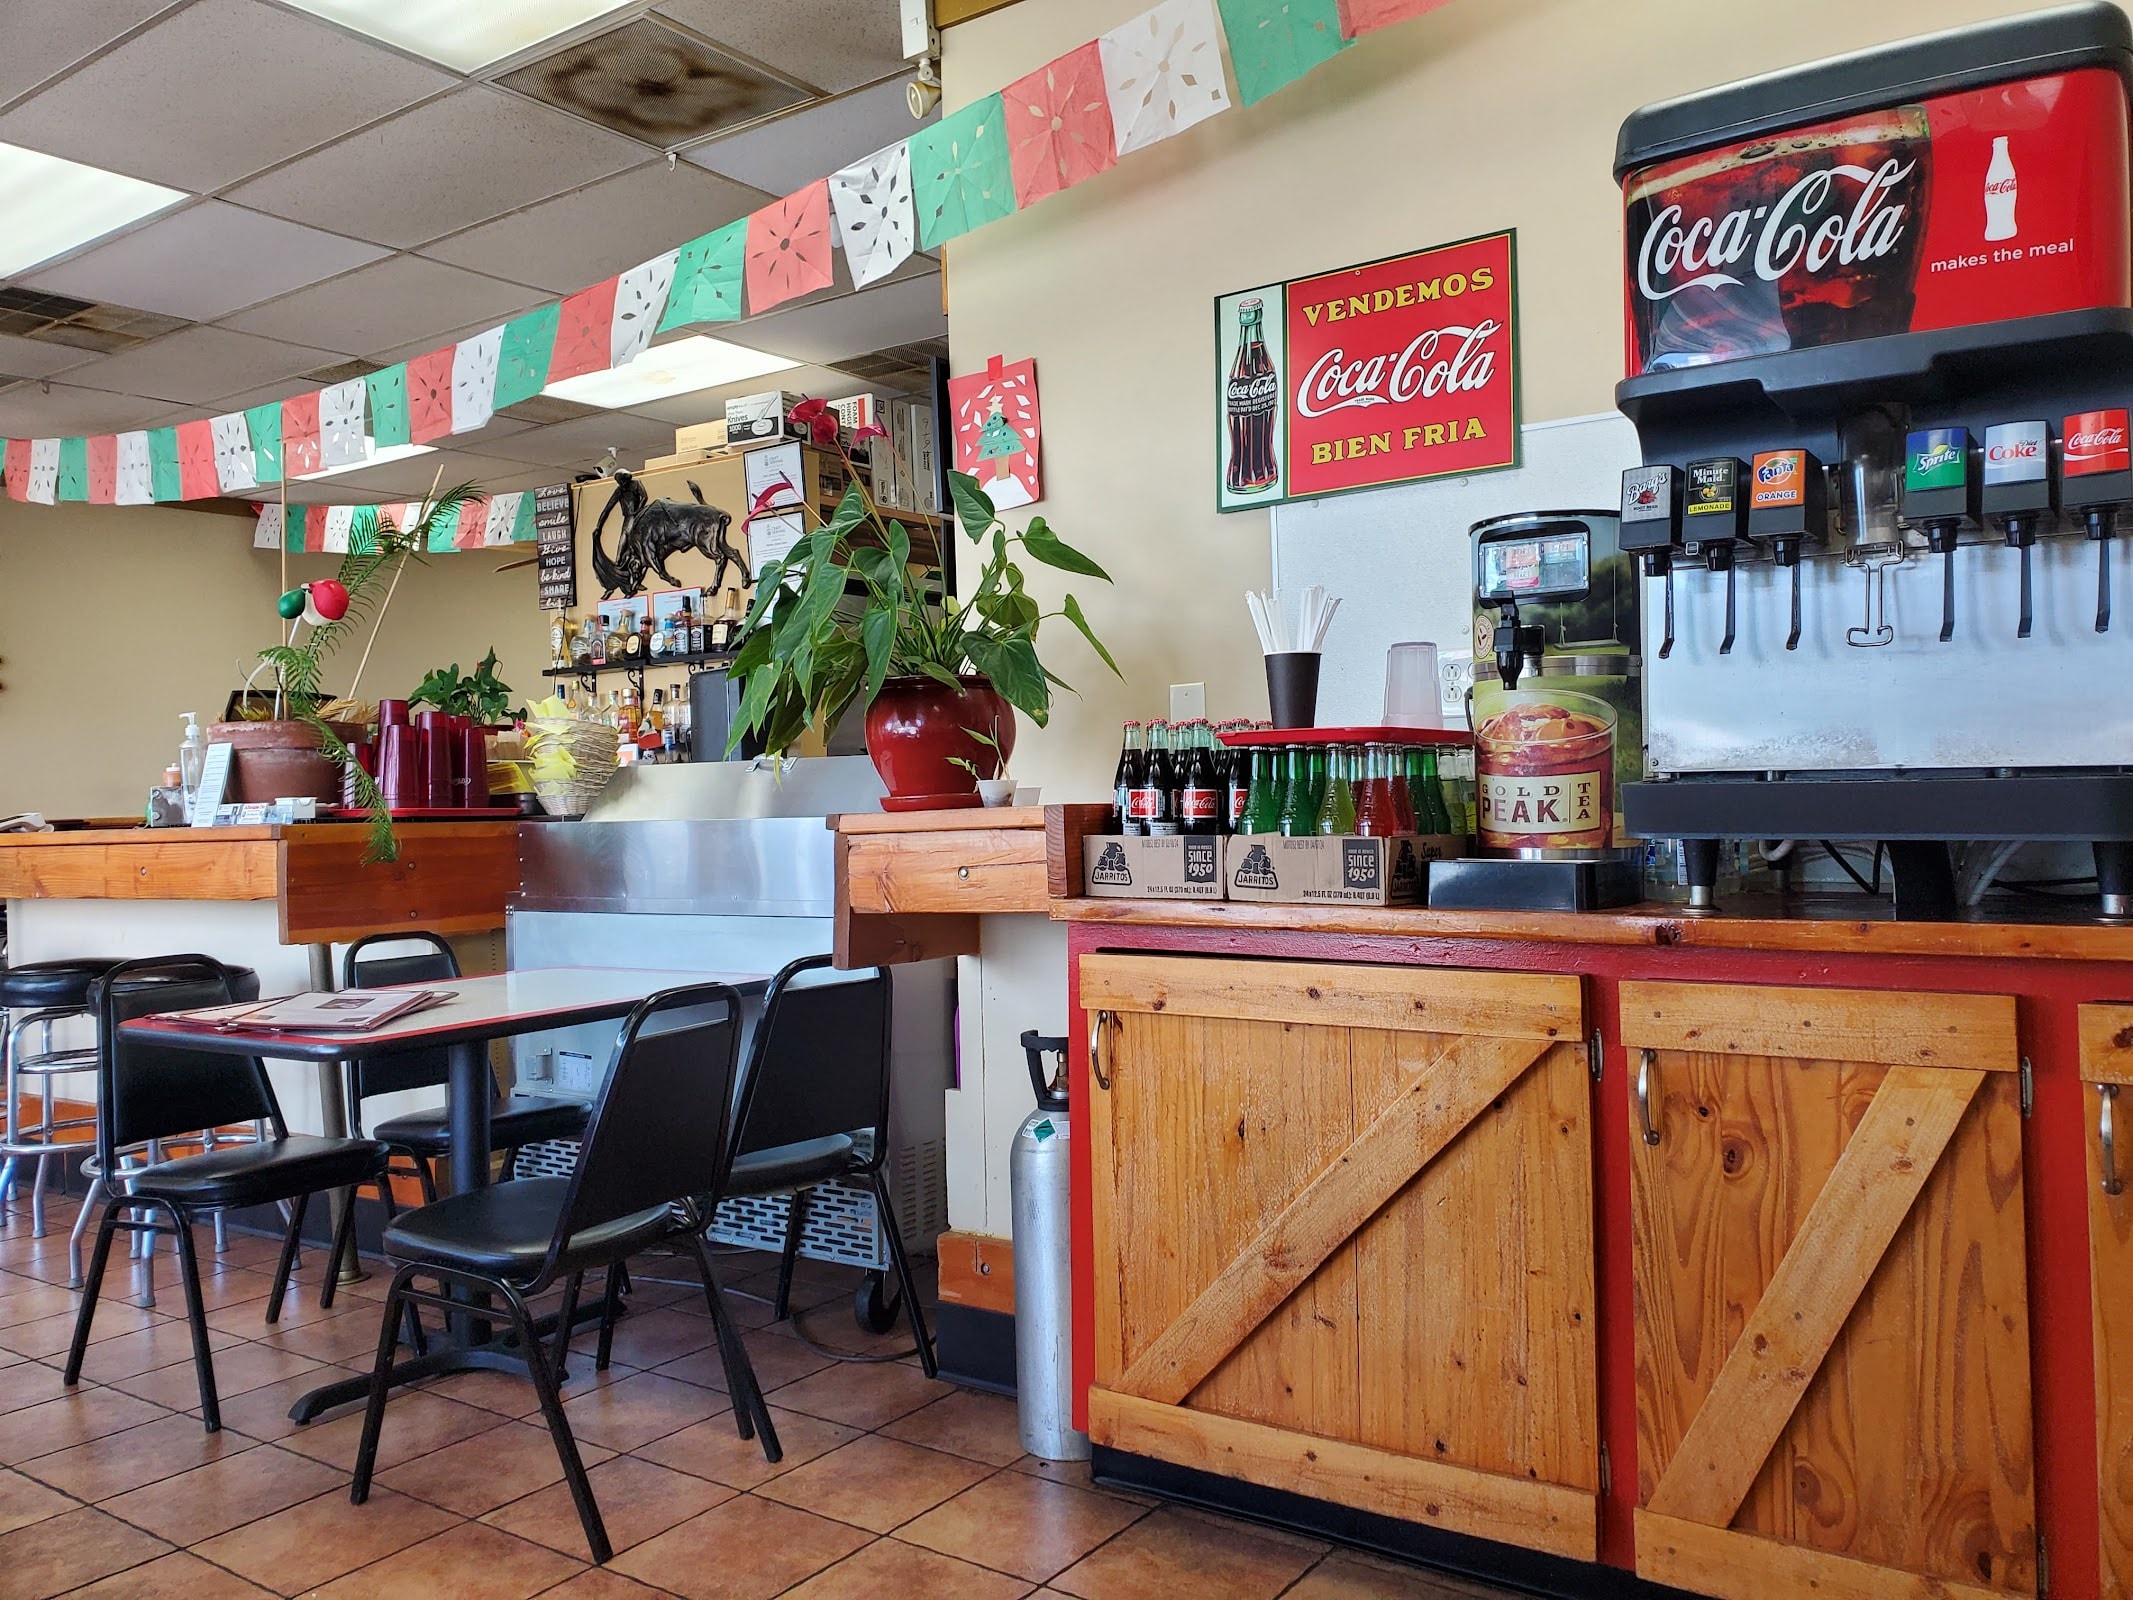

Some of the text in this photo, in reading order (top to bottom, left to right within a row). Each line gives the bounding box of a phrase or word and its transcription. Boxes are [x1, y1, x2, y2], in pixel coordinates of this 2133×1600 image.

[1637, 157, 1917, 300] Coca-Cola
[1930, 238, 2074, 273] makes the meal
[1302, 267, 1495, 327] VENDEMOS
[1297, 319, 1503, 419] Coca-Cola
[1228, 373, 1276, 399] Coca-Cola
[728, 415, 749, 424] Knives
[1311, 417, 1488, 466] BIEN FRIA
[2067, 427, 2125, 450] Coca-Cola
[1918, 449, 1957, 472] Sprite
[1989, 444, 2038, 462] Coke
[1693, 467, 1729, 478] Minute
[1696, 474, 1724, 485] Maid
[1757, 461, 1794, 483] Fanta
[538, 485, 568, 498] Love
[1626, 472, 1668, 506] Barq's
[1756, 490, 1797, 502] ORANGE
[536, 498, 569, 513] BELIEVE
[1689, 503, 1731, 513] LEMONADE
[539, 512, 569, 527] smile
[542, 529, 567, 542] LAUGH
[541, 543, 570, 556] Give
[545, 556, 566, 567] HOPE
[541, 567, 571, 582] be kind
[544, 584, 570, 596] SHARE
[1482, 783, 1561, 797] GOLD
[1576, 782, 1591, 820] TEA
[1482, 797, 1560, 823] PEAK
[1094, 872, 1128, 882] JARRITOS
[1188, 863, 1214, 877] 1950
[1348, 867, 1375, 882] 1950
[1238, 875, 1274, 886] JARRITOS
